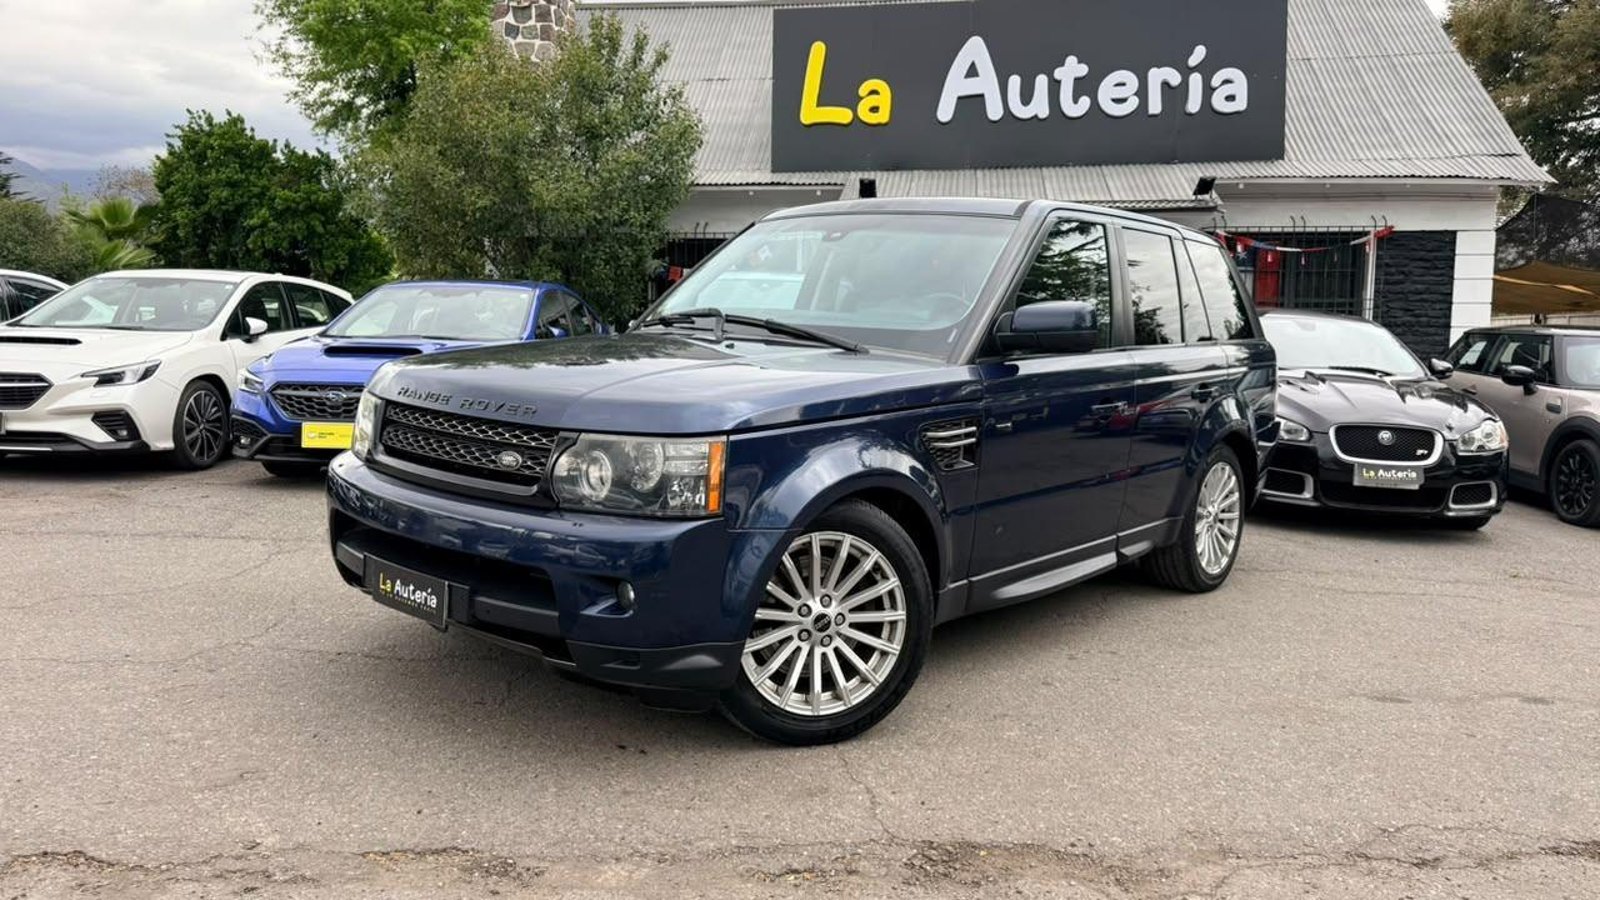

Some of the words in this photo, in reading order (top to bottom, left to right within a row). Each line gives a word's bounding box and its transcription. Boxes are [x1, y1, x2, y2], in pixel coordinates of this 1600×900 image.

[799, 40, 893, 126] La
[935, 35, 1249, 125] Autería
[397, 385, 453, 406] RANGE
[459, 397, 538, 418] ROVER
[1362, 467, 1376, 478] La
[379, 572, 392, 593] La
[394, 578, 438, 609] Autería
